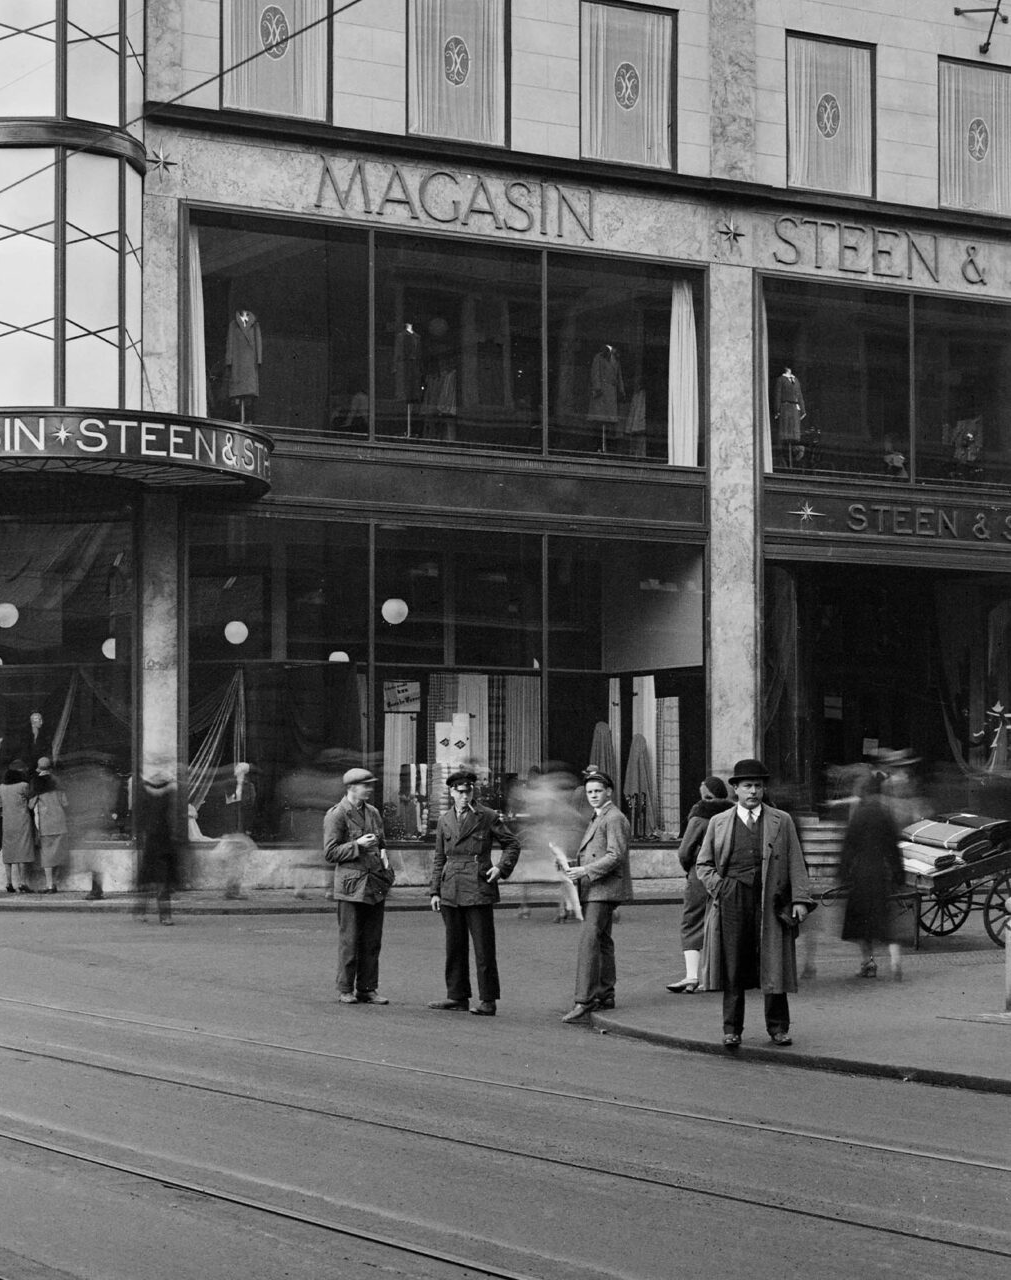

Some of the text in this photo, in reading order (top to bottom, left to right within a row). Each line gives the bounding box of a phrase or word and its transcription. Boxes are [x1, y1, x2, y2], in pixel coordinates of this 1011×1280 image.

[314, 154, 595, 241] MAGASIN
[772, 215, 988, 286] STEEN &
[76, 418, 217, 466] STEEN
[221, 432, 240, 469] &
[847, 503, 959, 538] STEEN
[972, 512, 992, 540] &
